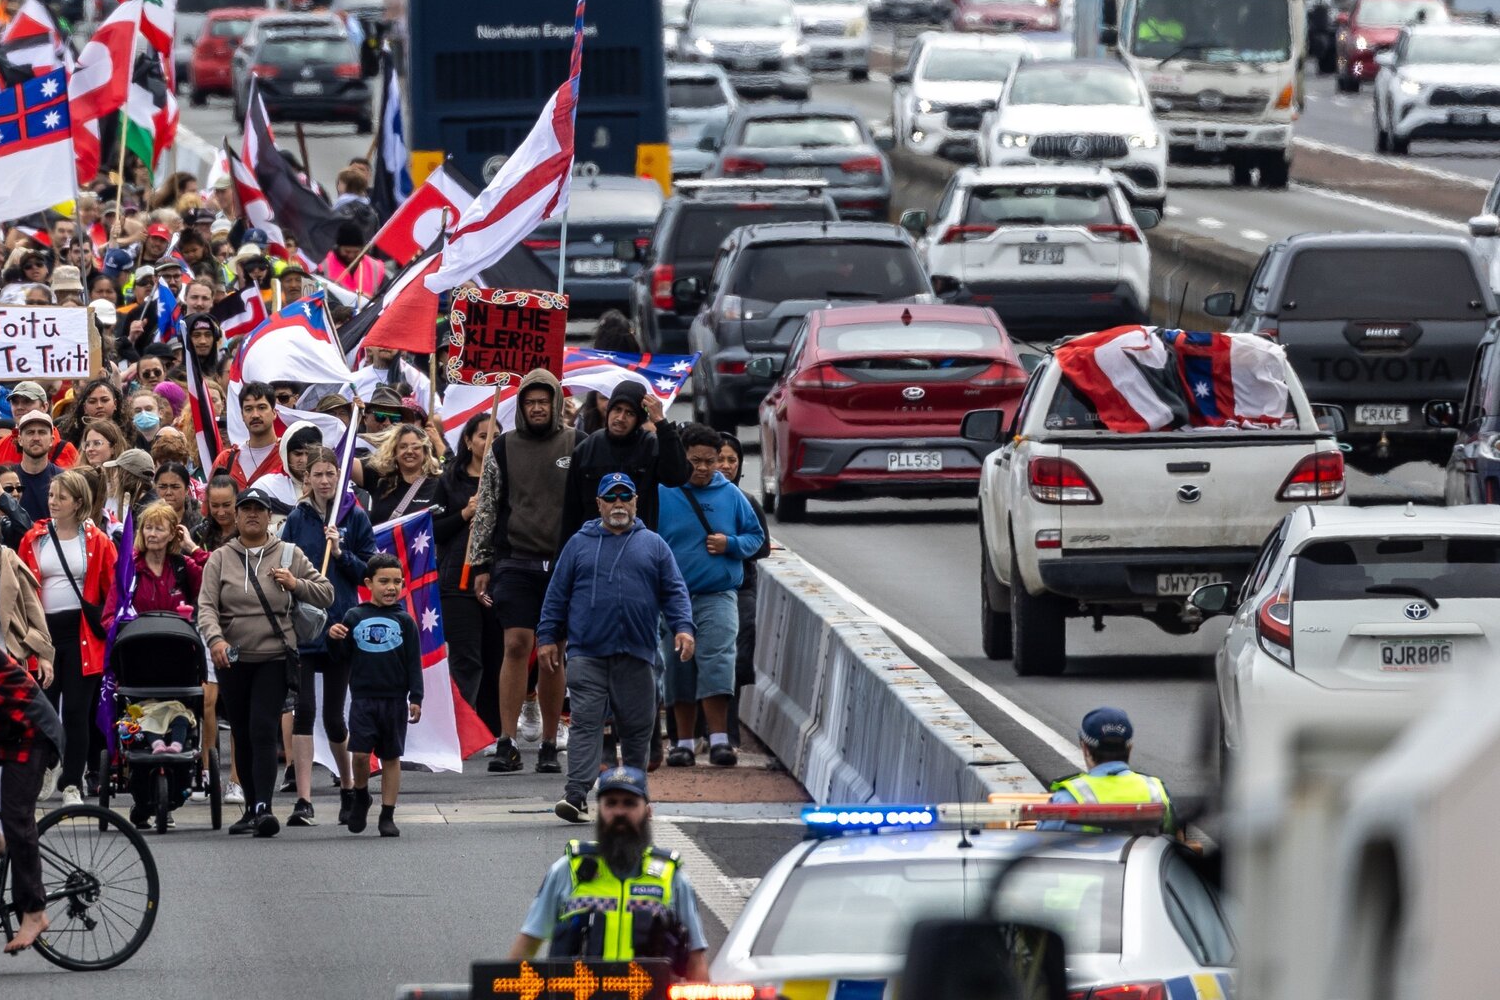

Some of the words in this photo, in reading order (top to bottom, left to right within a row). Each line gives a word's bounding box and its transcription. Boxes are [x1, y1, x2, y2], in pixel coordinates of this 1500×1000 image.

[477, 24, 540, 38] Northern
[543, 23, 598, 39] Exprss
[466, 304, 488, 326] IN
[496, 305, 550, 333] THE
[35, 344, 88, 373] Tiriti
[1311, 356, 1453, 382] TOYOTA
[1361, 407, 1402, 421] CRAKE
[889, 453, 940, 468] PLL535
[1382, 645, 1451, 665] QJR806
